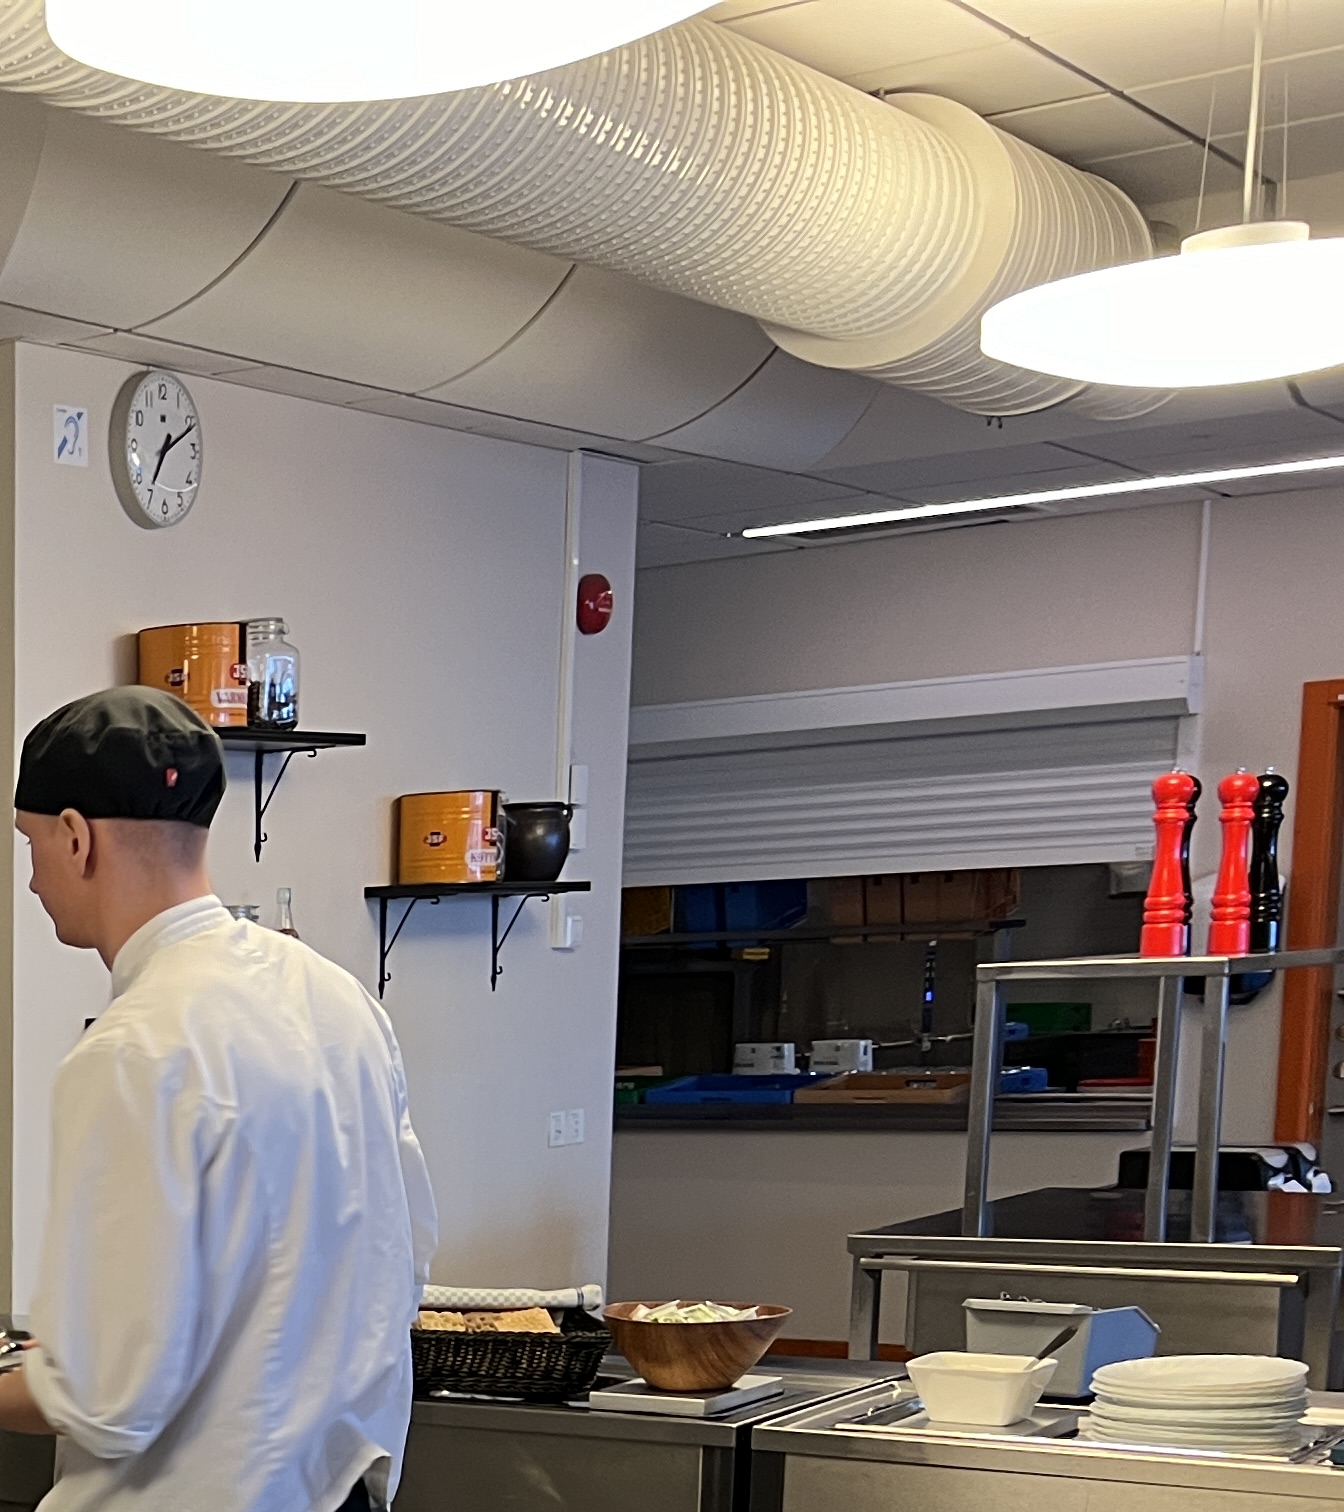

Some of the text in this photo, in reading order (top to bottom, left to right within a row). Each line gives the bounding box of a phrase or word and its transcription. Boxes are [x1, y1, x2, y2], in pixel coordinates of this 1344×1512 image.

[145, 389, 154, 408] 11
[158, 383, 167, 401] 12
[135, 410, 144, 427] 10
[190, 443, 199, 460] 3
[135, 467, 143, 485] 8
[185, 471, 193, 485] 4
[147, 488, 154, 511] 7
[161, 498, 169, 515] 6
[177, 491, 184, 508] 5
